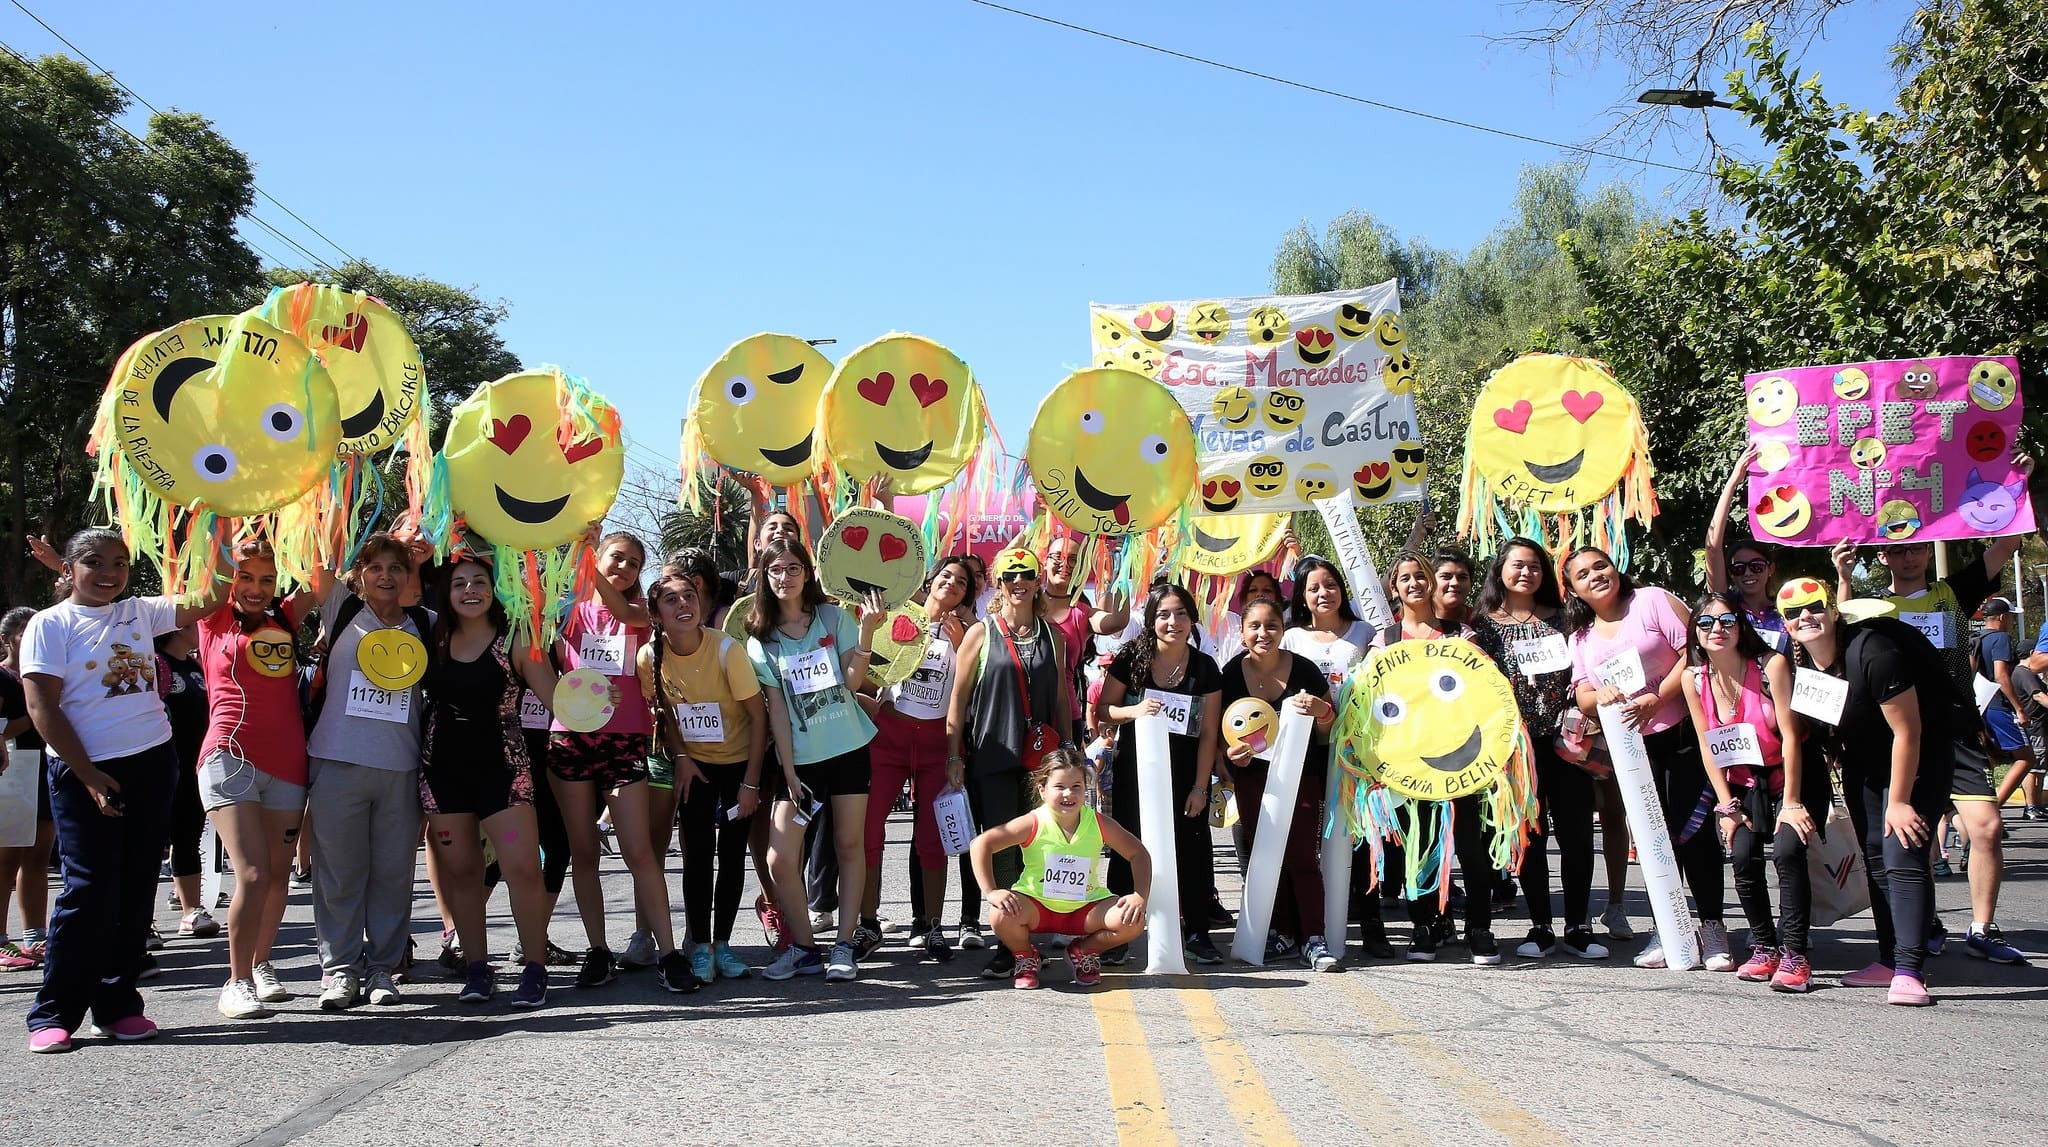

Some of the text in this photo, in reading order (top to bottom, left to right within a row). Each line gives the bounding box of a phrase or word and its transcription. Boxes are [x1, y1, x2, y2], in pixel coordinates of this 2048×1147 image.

[1245, 346, 1368, 387] Mercedes
[122, 389, 139, 408] DE
[381, 362, 418, 437] BALCARCE
[122, 415, 140, 433] LA
[1797, 400, 1969, 447] EPET
[1285, 423, 1315, 452] de
[1501, 474, 1575, 505] EPET 4
[1040, 468, 1080, 519] SAN
[1091, 514, 1137, 534] JOSE
[1013, 514, 1025, 522] DE
[849, 510, 891, 521] ANTONIO
[896, 519, 925, 561] BALCARCE
[969, 524, 1013, 544] SAN
[582, 647, 620, 662] 11753
[926, 650, 941, 661] 94
[1518, 649, 1554, 665] 04631
[791, 662, 828, 681] 11749
[1603, 666, 1634, 687] 04799
[351, 686, 392, 706] 11731
[1796, 682, 1830, 704] 04797
[524, 702, 545, 716] 729
[682, 715, 719, 729] 11706
[1711, 737, 1751, 756] 04638
[945, 813, 962, 851] 11732
[1045, 868, 1085, 886] 04792
